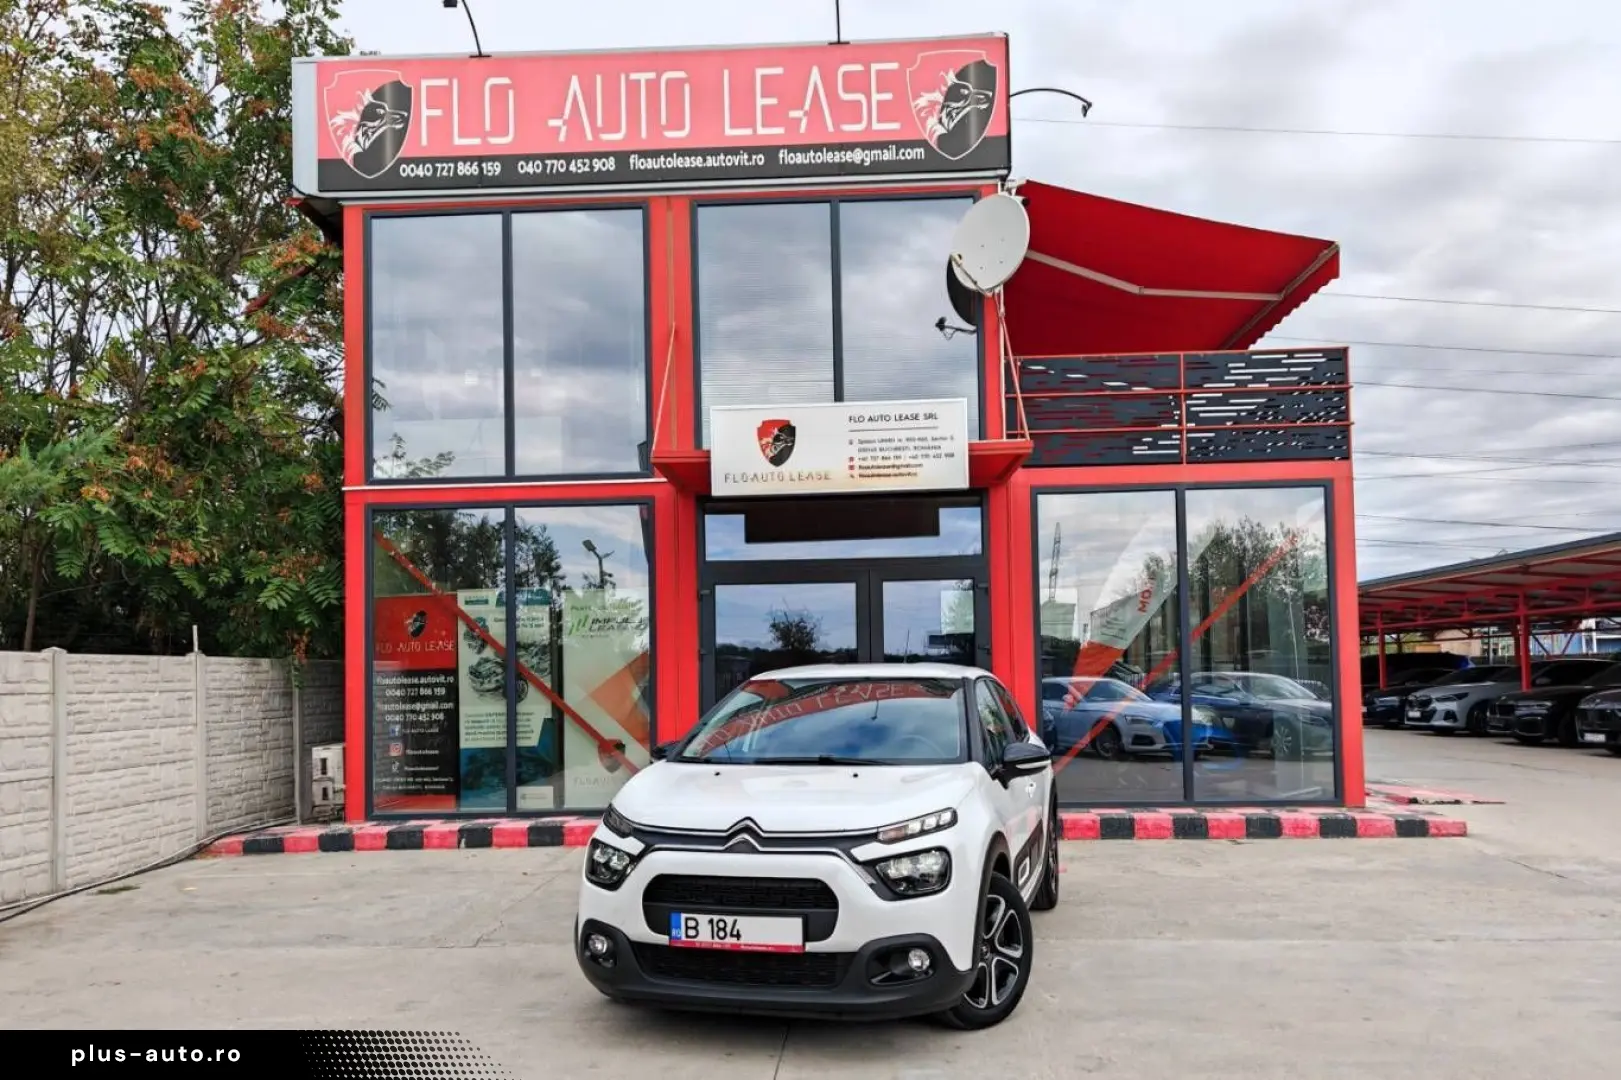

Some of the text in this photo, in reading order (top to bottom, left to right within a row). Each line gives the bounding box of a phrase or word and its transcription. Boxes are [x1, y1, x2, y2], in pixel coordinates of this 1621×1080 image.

[420, 62, 901, 147] FLO AUTO LEASE
[400, 146, 925, 178] 0040 727 866 159 040 770 452 908 floautolease.autovit.ro floautolease@gmail.com
[848, 411, 939, 424] FLO AUTO LEASE SRL
[724, 470, 833, 484] FLO AUTO LEASE
[375, 639, 455, 654] LO AUTO LEASE
[684, 916, 742, 941] B 184
